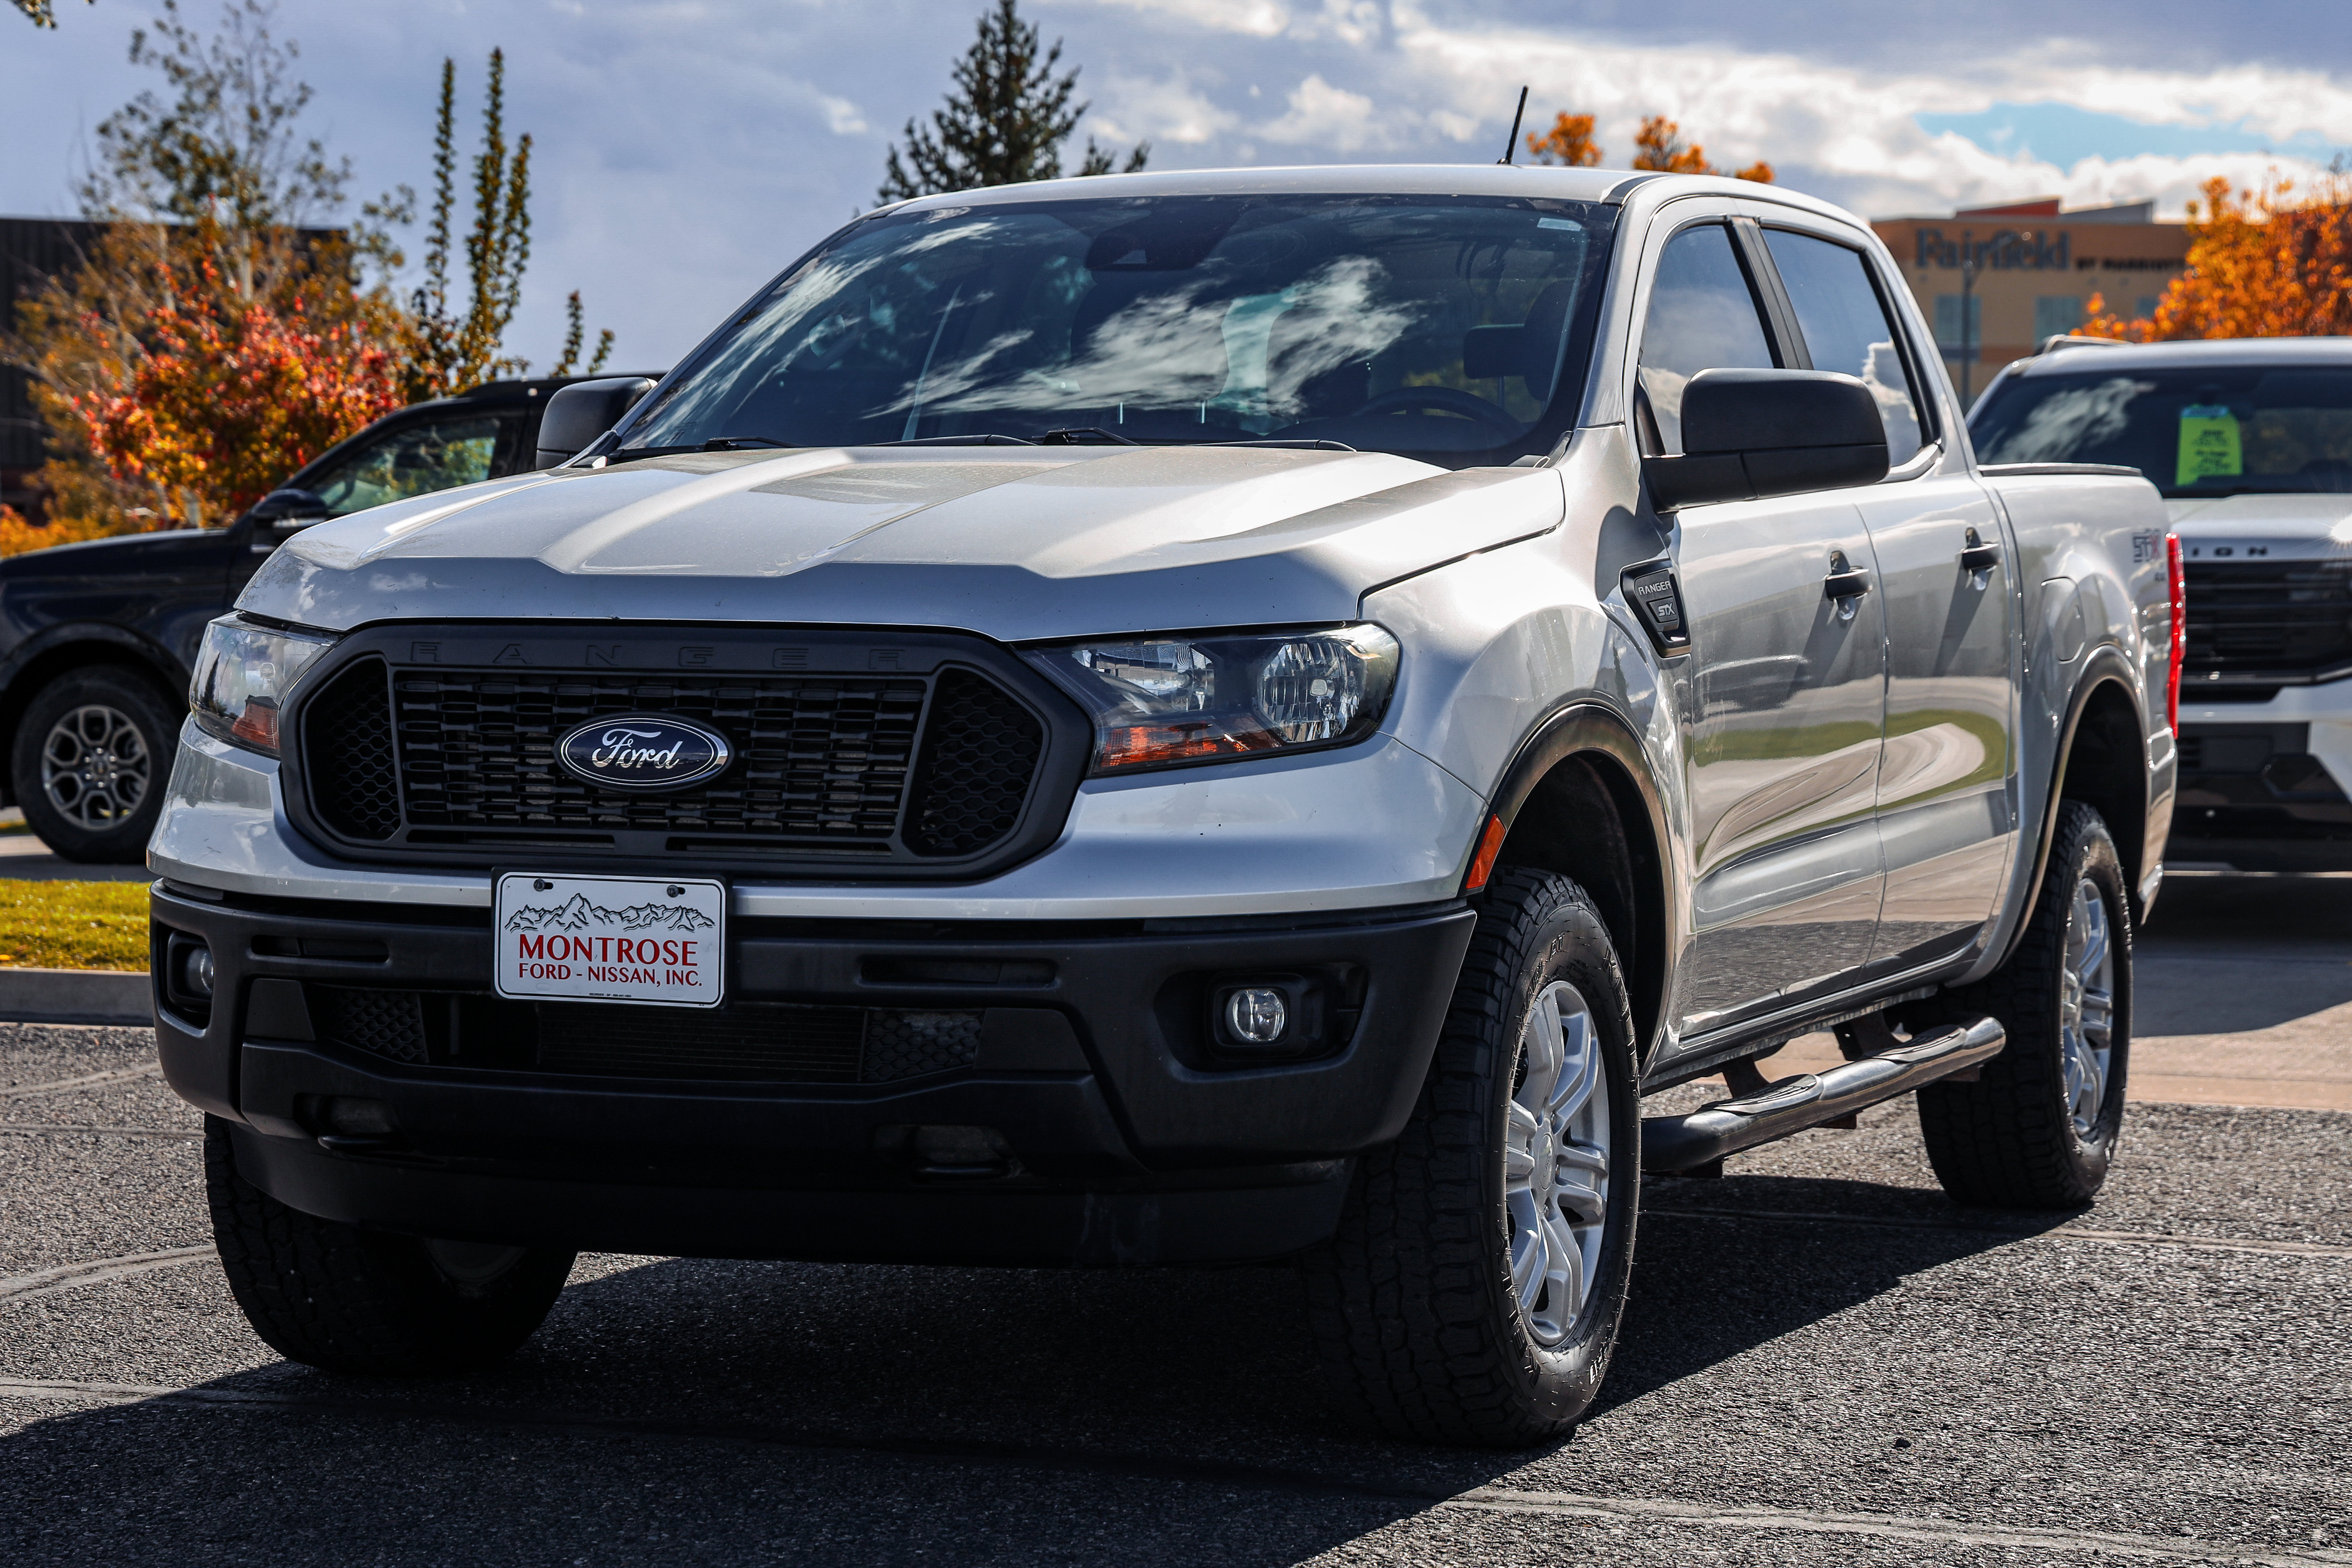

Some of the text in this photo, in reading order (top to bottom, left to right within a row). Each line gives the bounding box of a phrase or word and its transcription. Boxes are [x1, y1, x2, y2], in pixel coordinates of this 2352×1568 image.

[1917, 228, 2070, 270] Fairfield
[1638, 581, 1672, 596] RANGER
[1658, 602, 1676, 617] STX
[409, 641, 906, 670] RANGER
[591, 729, 683, 769] Ford
[519, 934, 698, 967] MONTROSE
[519, 963, 571, 980] FORD
[588, 966, 661, 987] NISSAN,
[666, 969, 702, 987] INC.
